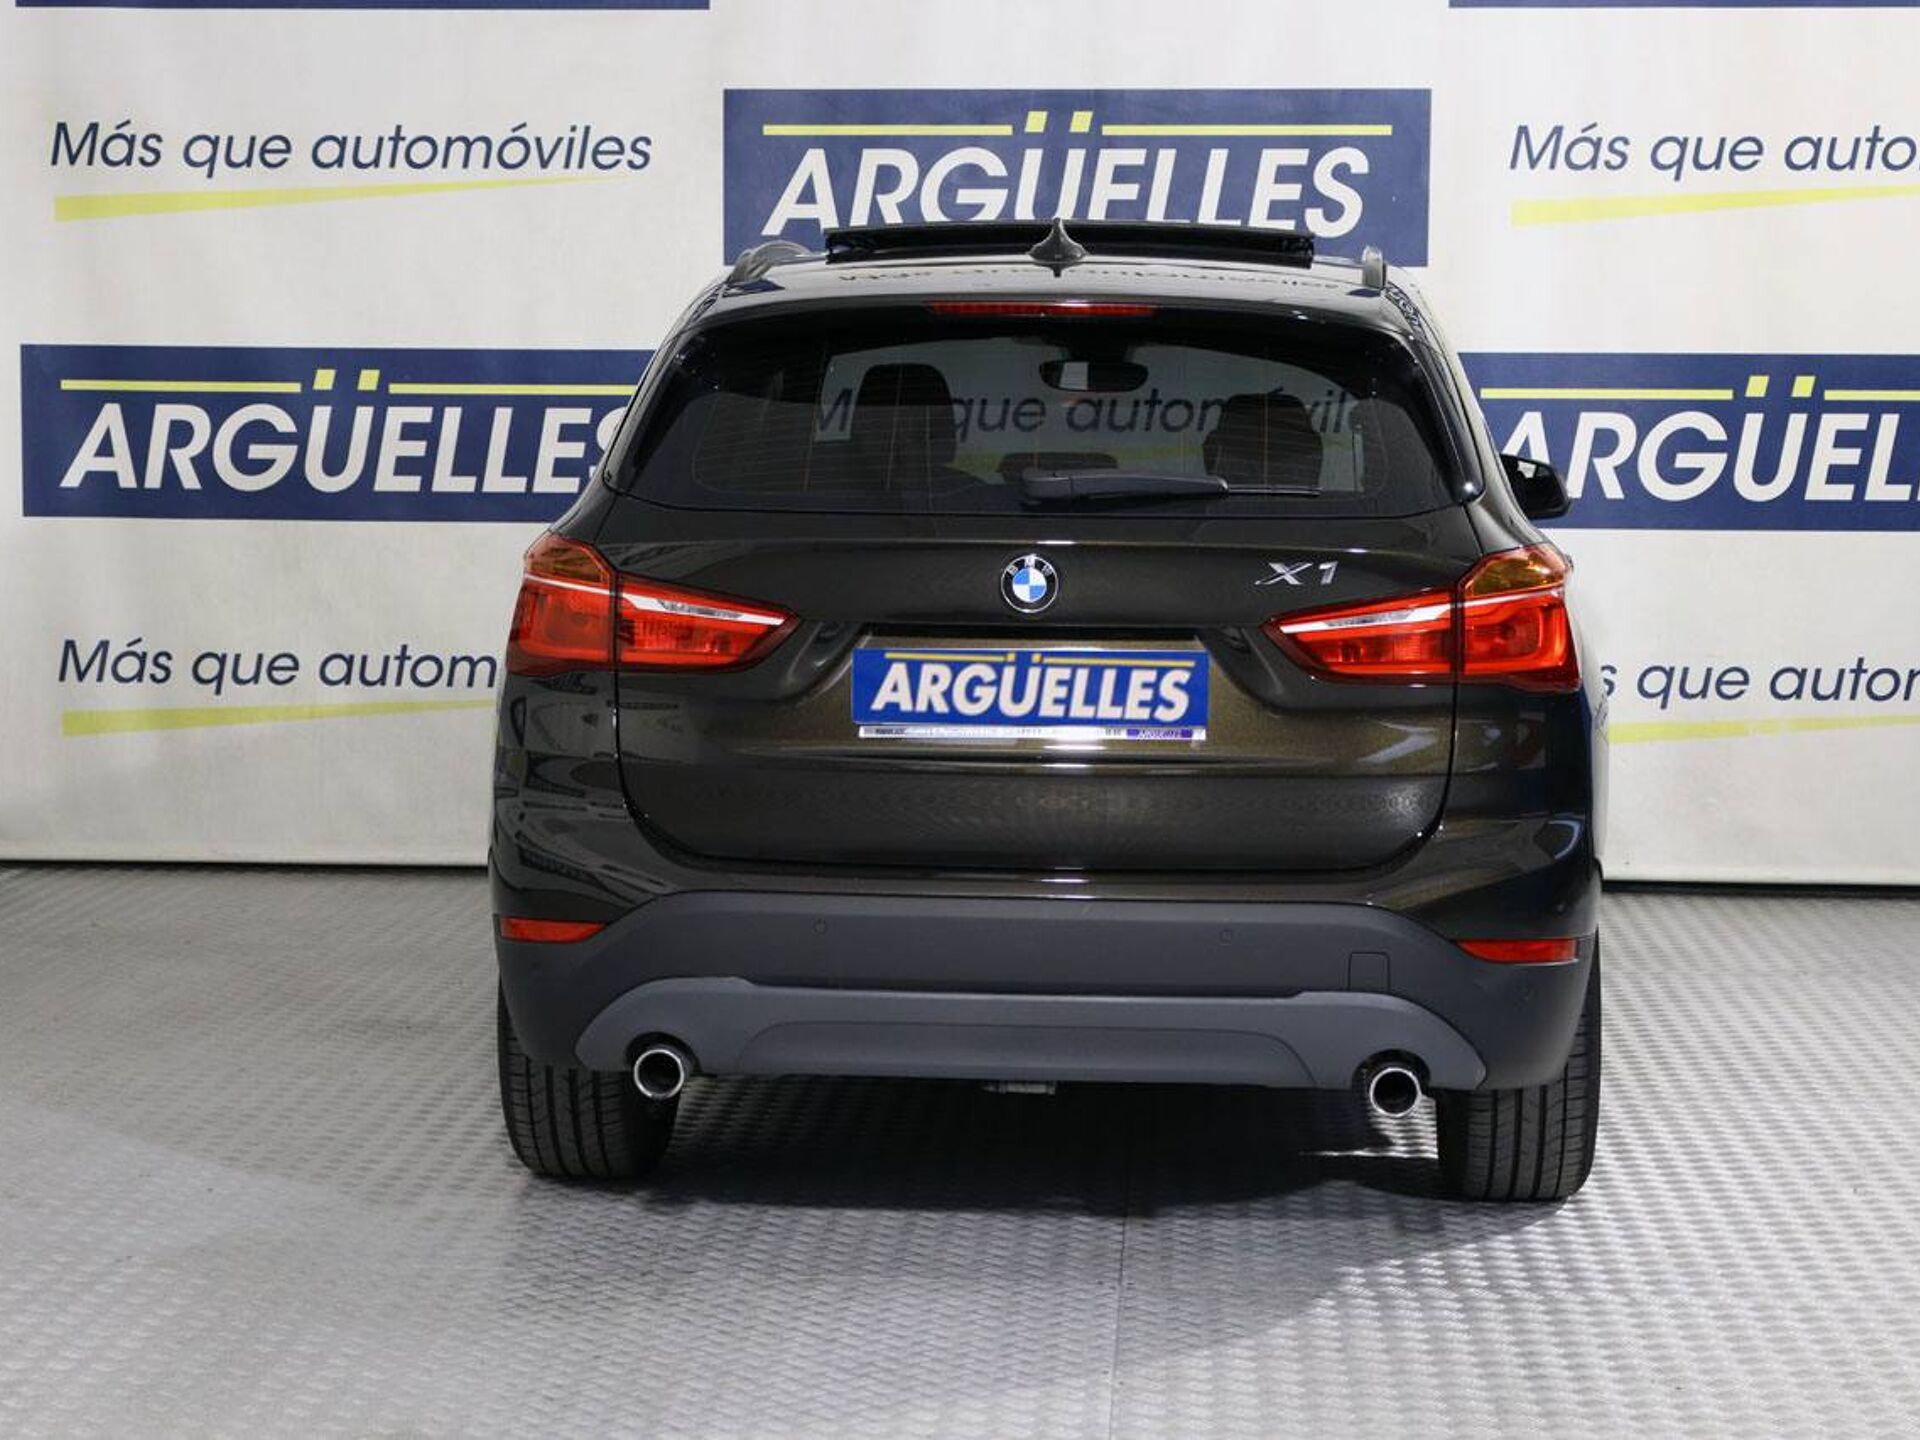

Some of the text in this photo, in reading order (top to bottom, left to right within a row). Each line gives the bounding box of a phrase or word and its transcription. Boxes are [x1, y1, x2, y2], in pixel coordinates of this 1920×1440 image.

[51, 119, 652, 179] Más que automóviles
[761, 111, 1371, 239] ARGÜELLES
[1510, 122, 1630, 171] Más
[1650, 135, 1765, 181] que
[1501, 375, 1920, 502] ARGÜEL
[1254, 560, 1339, 586] X1
[58, 637, 498, 696] Más que autom
[871, 652, 1191, 722] ARGÜELLES
[1637, 665, 1750, 710] que
